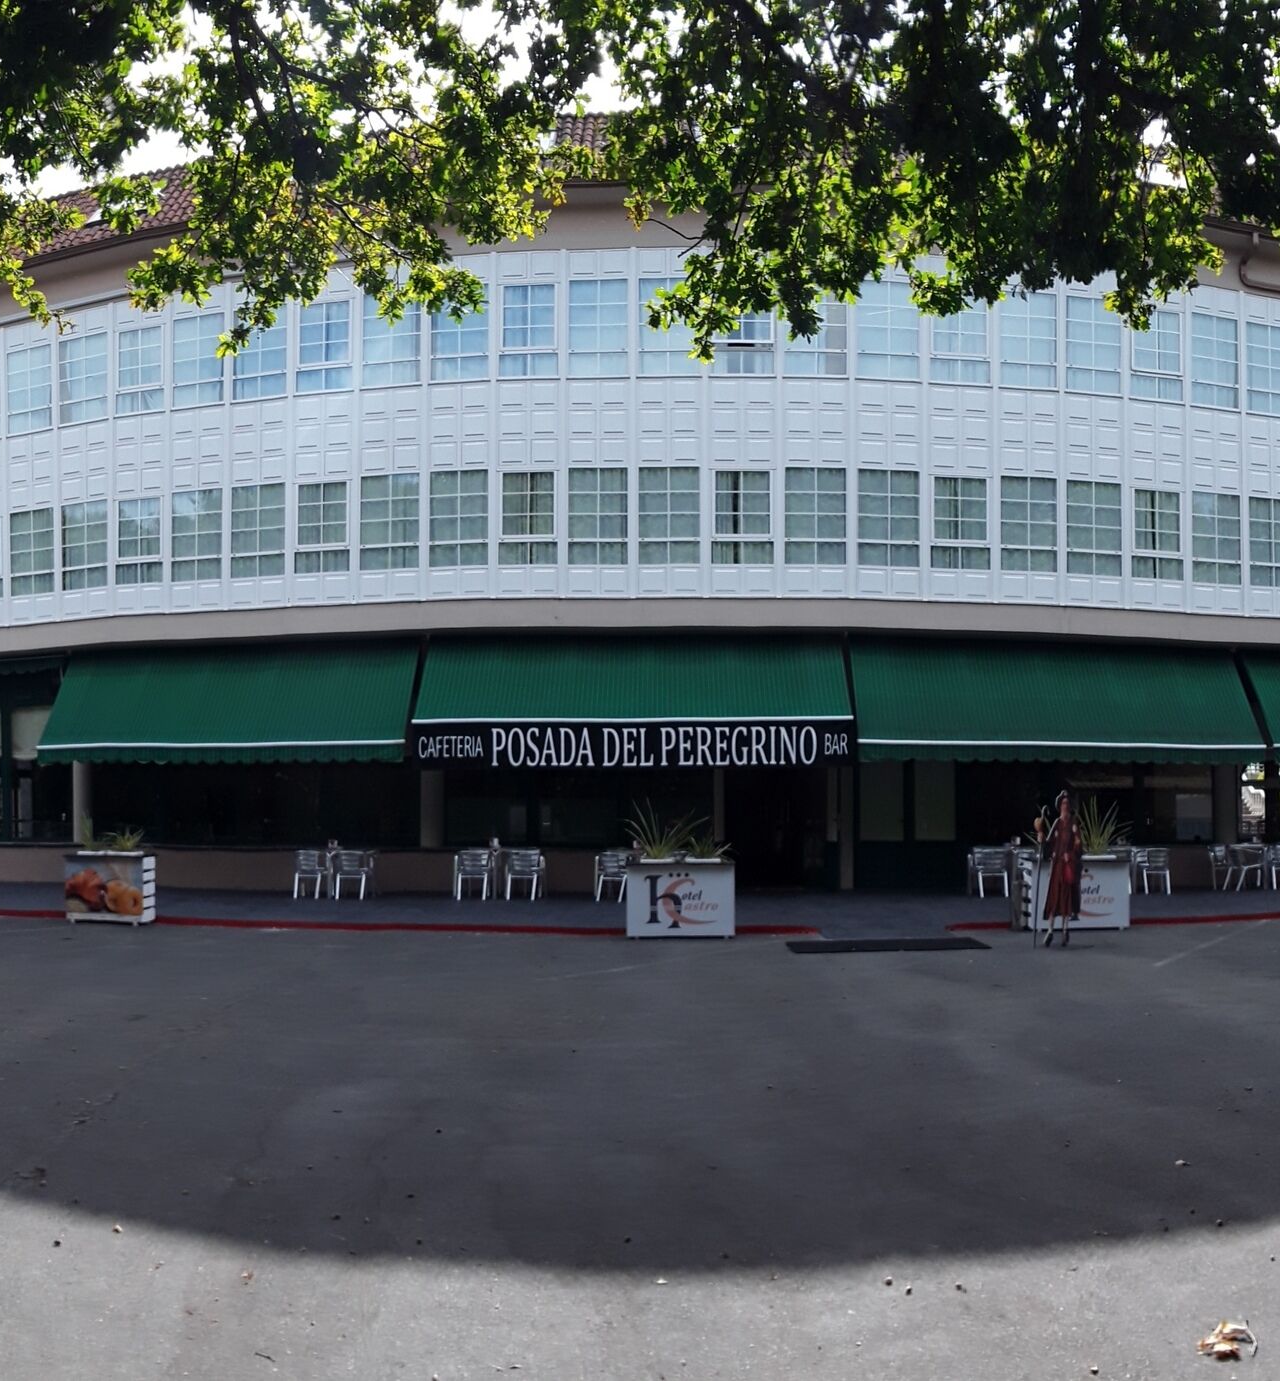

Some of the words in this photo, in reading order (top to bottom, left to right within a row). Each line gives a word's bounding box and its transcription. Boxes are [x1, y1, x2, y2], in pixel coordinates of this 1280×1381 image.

[418, 736, 484, 758] CAFETERIA
[491, 727, 595, 767] POSADA
[602, 727, 654, 767] DEL
[660, 725, 818, 766] PEREGRINO
[824, 733, 849, 755] BAR
